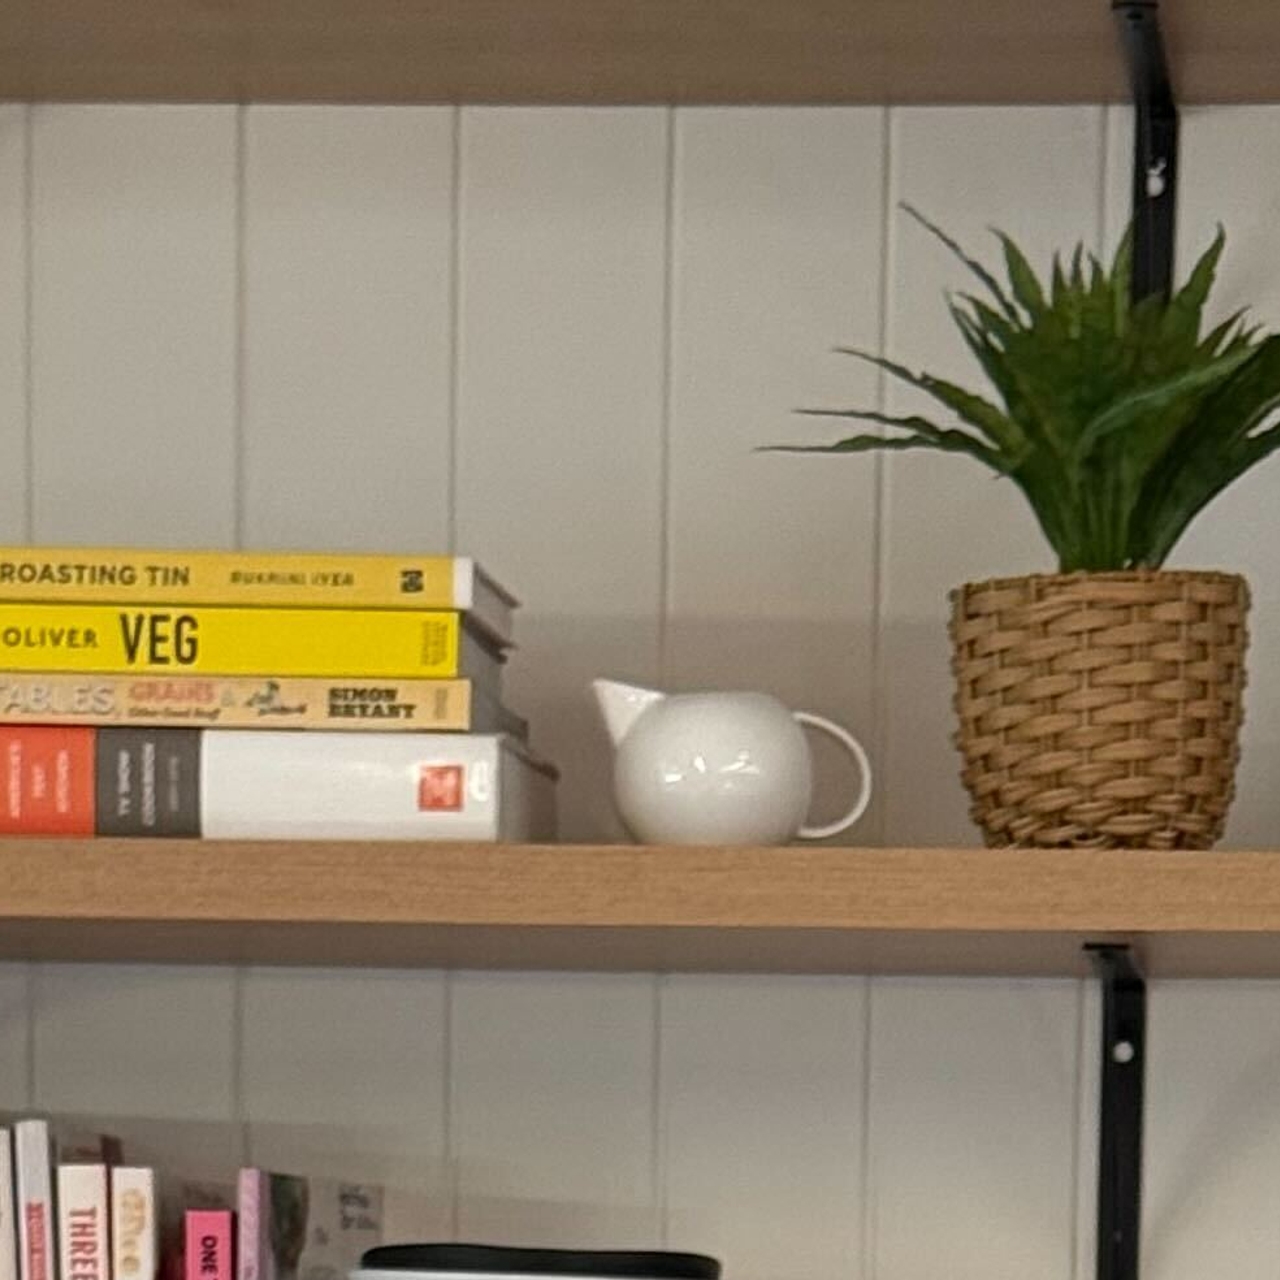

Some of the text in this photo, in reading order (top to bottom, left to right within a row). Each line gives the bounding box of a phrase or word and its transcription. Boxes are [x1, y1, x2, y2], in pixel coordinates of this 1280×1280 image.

[0, 563, 137, 586] ROASTING
[146, 566, 190, 586] TIN
[3, 627, 98, 648] OLIVER
[120, 613, 198, 666] VEG
[328, 687, 398, 702] SIMON
[327, 703, 418, 720] BRYANT
[200, 1233, 219, 1273] ONE
